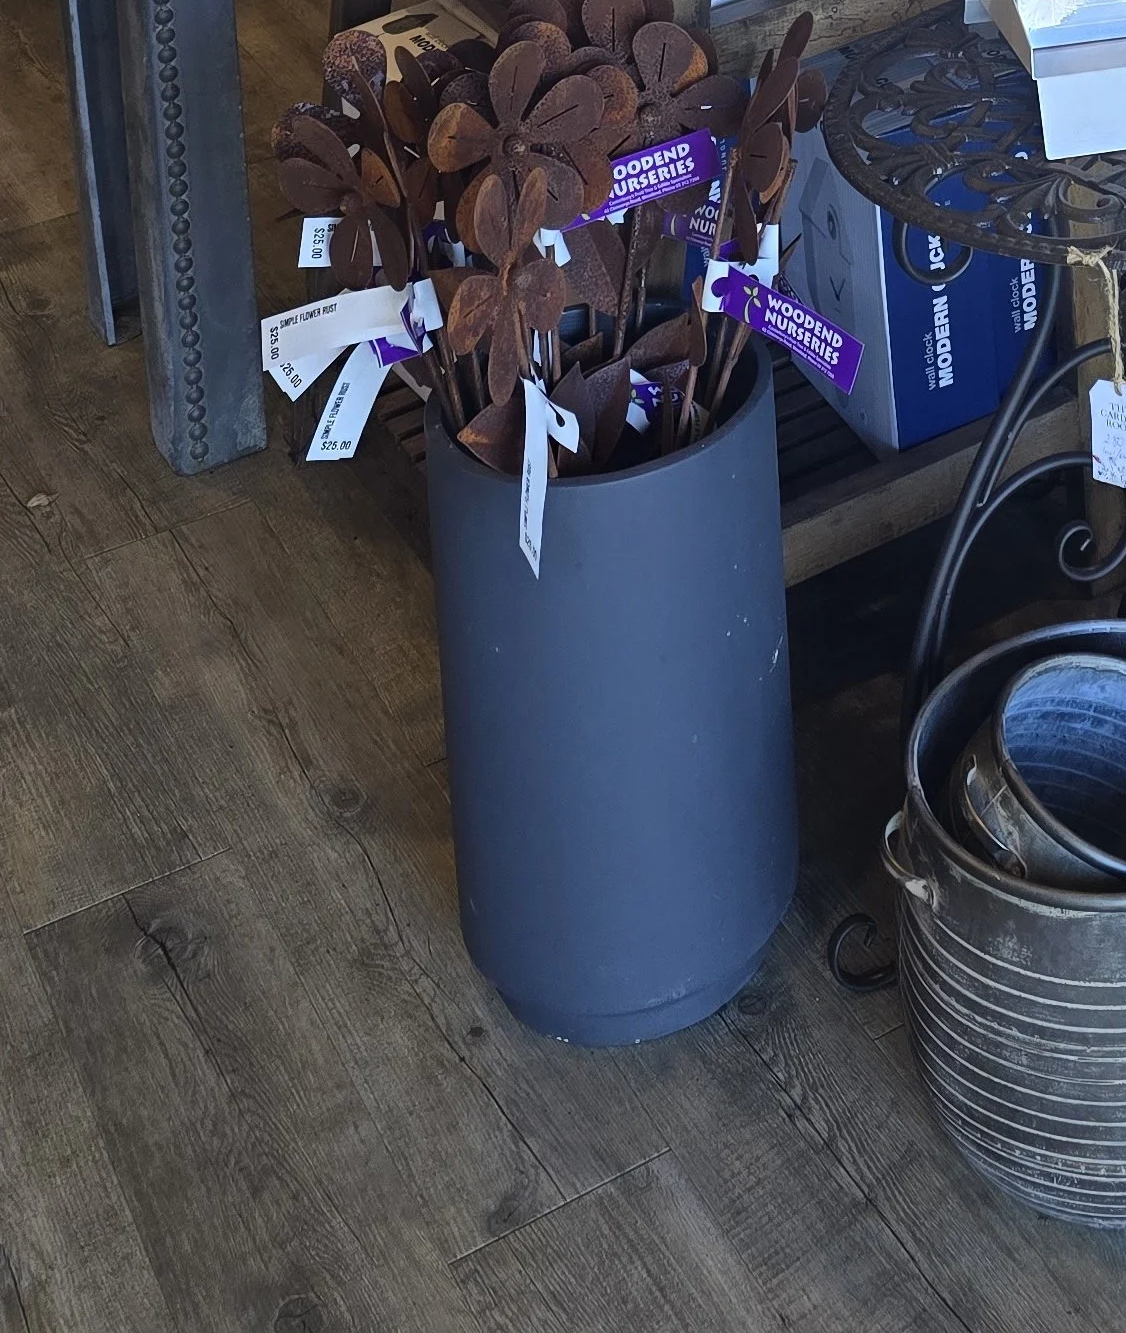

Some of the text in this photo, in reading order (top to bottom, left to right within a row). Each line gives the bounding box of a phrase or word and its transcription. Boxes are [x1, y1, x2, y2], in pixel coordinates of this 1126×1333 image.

[409, 35, 437, 52] MOD
[613, 143, 690, 180] OODEND
[719, 138, 728, 171] JUNGL
[608, 156, 695, 199] URSERIES
[311, 227, 325, 259] $25.00
[279, 302, 338, 329] SIMPLE FLOWER RUST
[1010, 276, 1021, 333] wall clock
[1020, 258, 1038, 331] MODER
[269, 325, 280, 360] $25.00
[764, 308, 840, 365] NURSERIES
[767, 294, 843, 348] WOODEND
[932, 290, 954, 388] MODERN
[922, 331, 936, 390] wall clock
[320, 381, 351, 440] SIMPLE FLOWER RUST
[320, 440, 352, 451] $25.00
